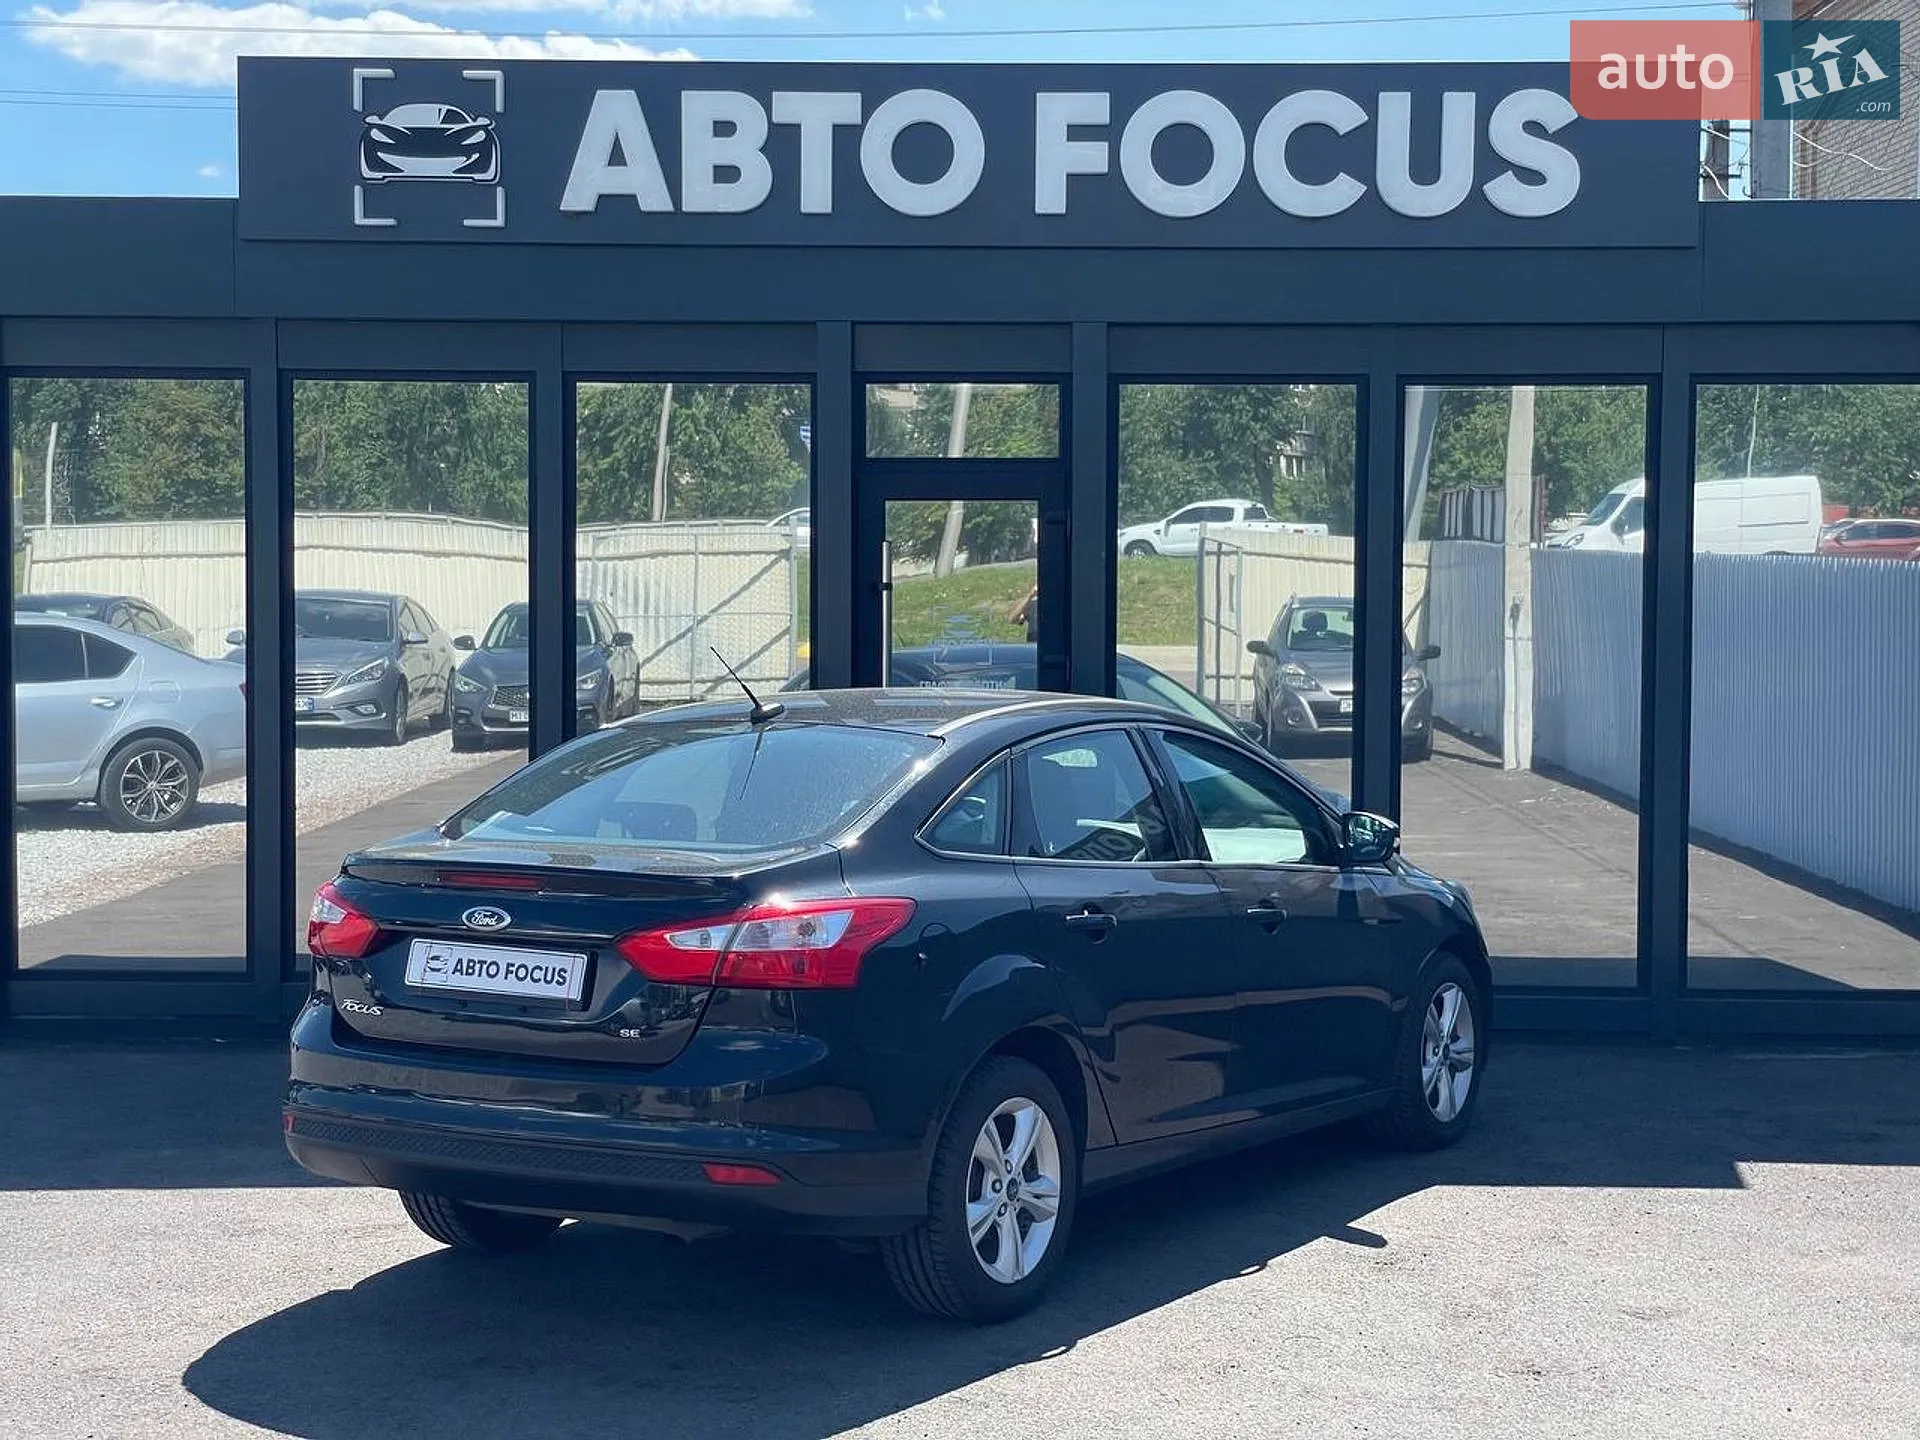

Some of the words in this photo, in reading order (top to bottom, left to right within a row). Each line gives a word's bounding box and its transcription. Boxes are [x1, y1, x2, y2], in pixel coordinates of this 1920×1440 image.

[559, 88, 986, 217] АВТО
[1034, 88, 1581, 219] FOCUS
[470, 909, 499, 926] Ford
[451, 957, 500, 979] АВТО
[504, 962, 568, 987] FOCUS
[619, 1028, 641, 1038] SE
